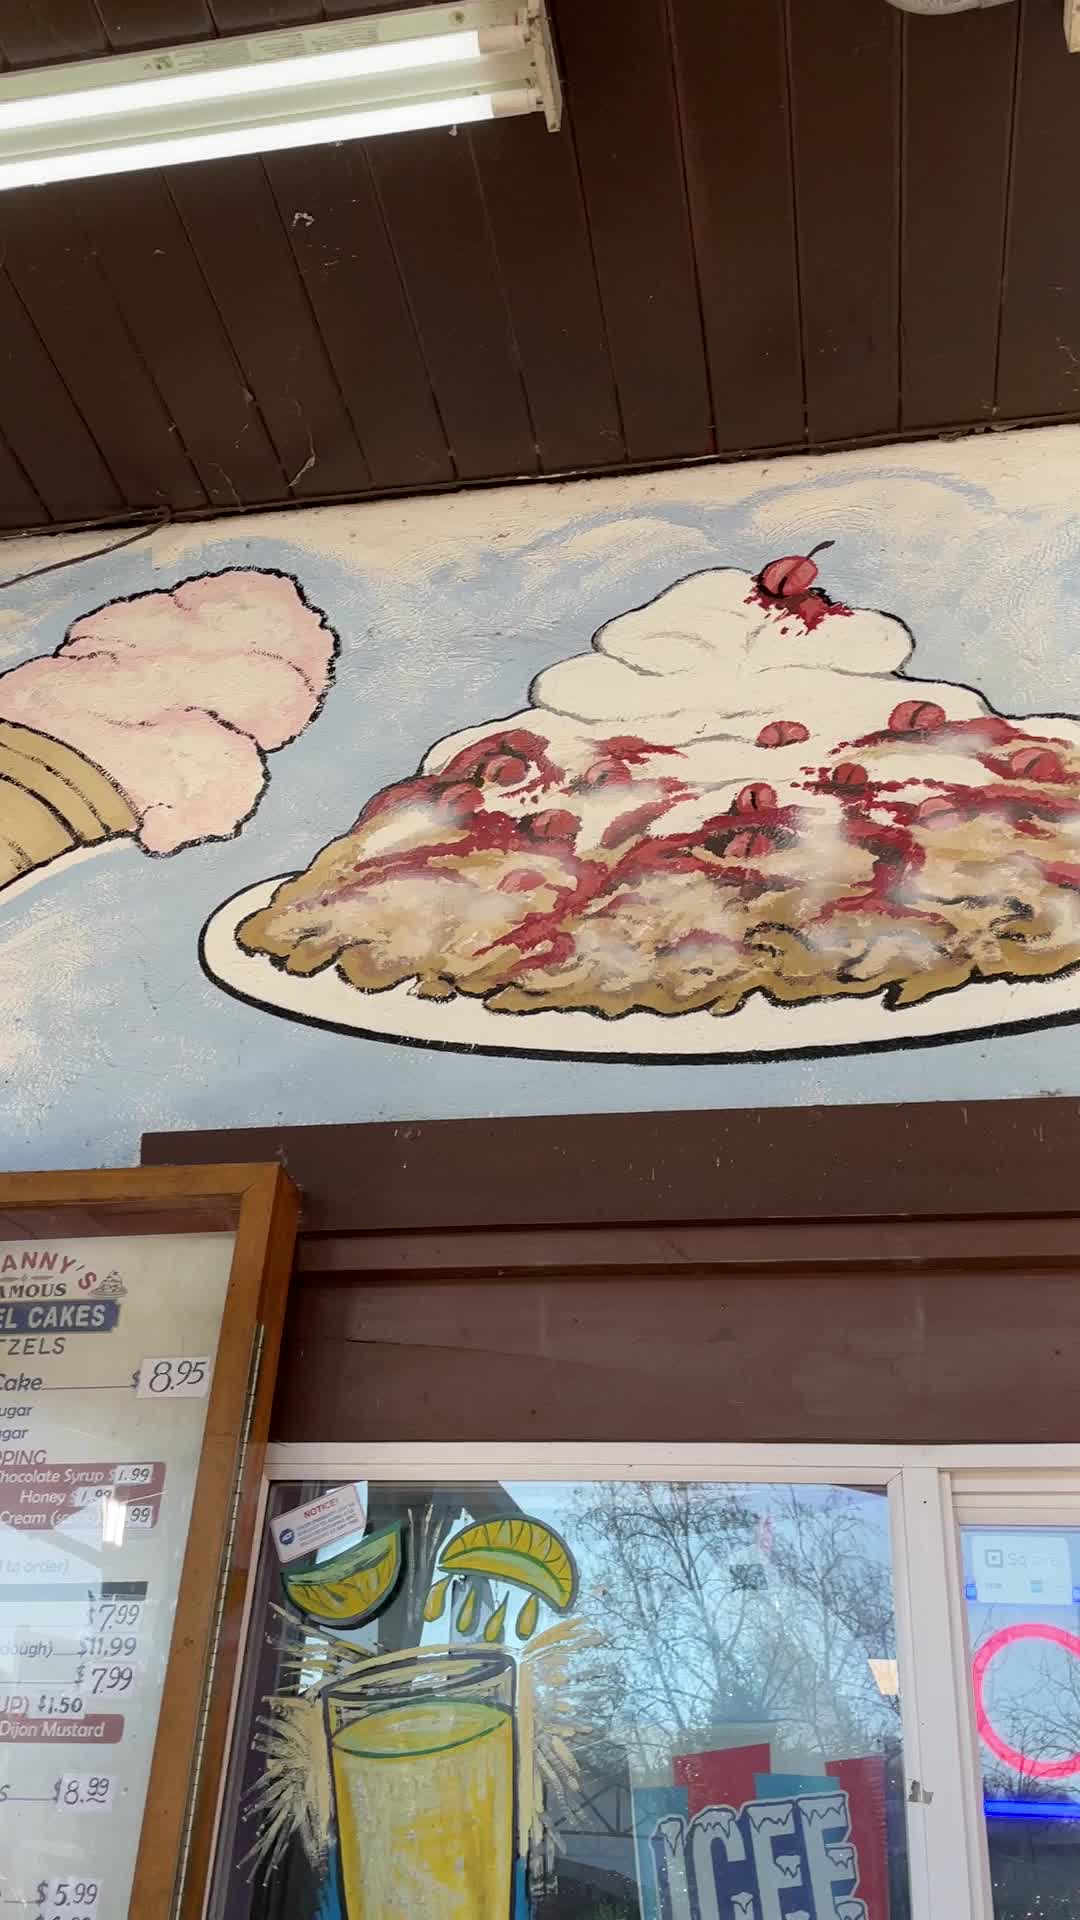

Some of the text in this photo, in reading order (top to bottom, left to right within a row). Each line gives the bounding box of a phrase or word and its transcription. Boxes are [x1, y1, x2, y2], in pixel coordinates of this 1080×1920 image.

[28, 1304, 106, 1328] CAKES
[0, 1450, 47, 1466] PING
[0, 1470, 60, 1484] hocolate
[64, 1468, 104, 1485] Syrup
[20, 1489, 66, 1507] Honey
[0, 1511, 47, 1525] Cream
[38, 1695, 83, 1714] $1.50
[0, 1721, 105, 1739] Dijon Mustard
[650, 1791, 868, 1920] ICEE
